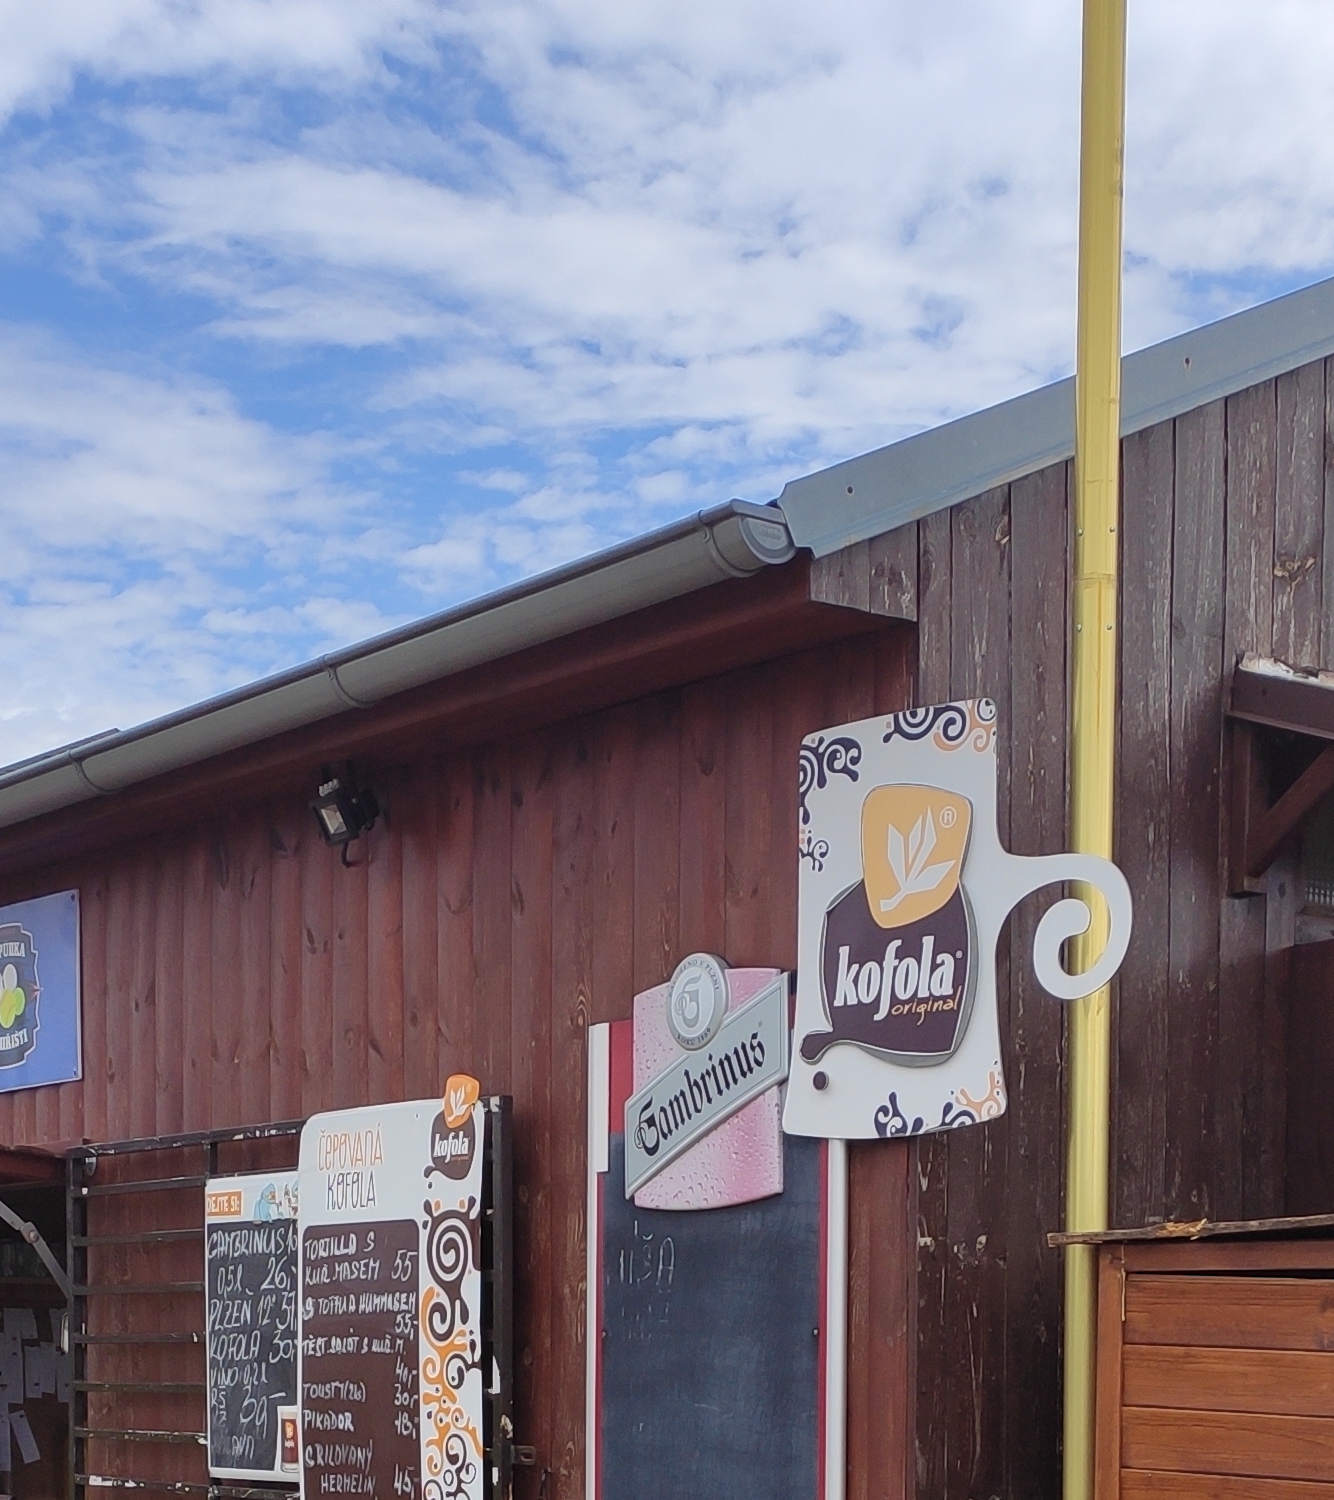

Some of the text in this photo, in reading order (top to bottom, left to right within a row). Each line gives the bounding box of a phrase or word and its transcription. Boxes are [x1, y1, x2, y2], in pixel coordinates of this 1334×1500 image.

[834, 935, 955, 1021] kofola
[891, 985, 963, 1027] original
[634, 1031, 765, 1156] Gambrinus
[432, 1131, 469, 1163] kofola
[363, 1231, 375, 1252] S
[303, 1409, 355, 1434] PIKADOR
